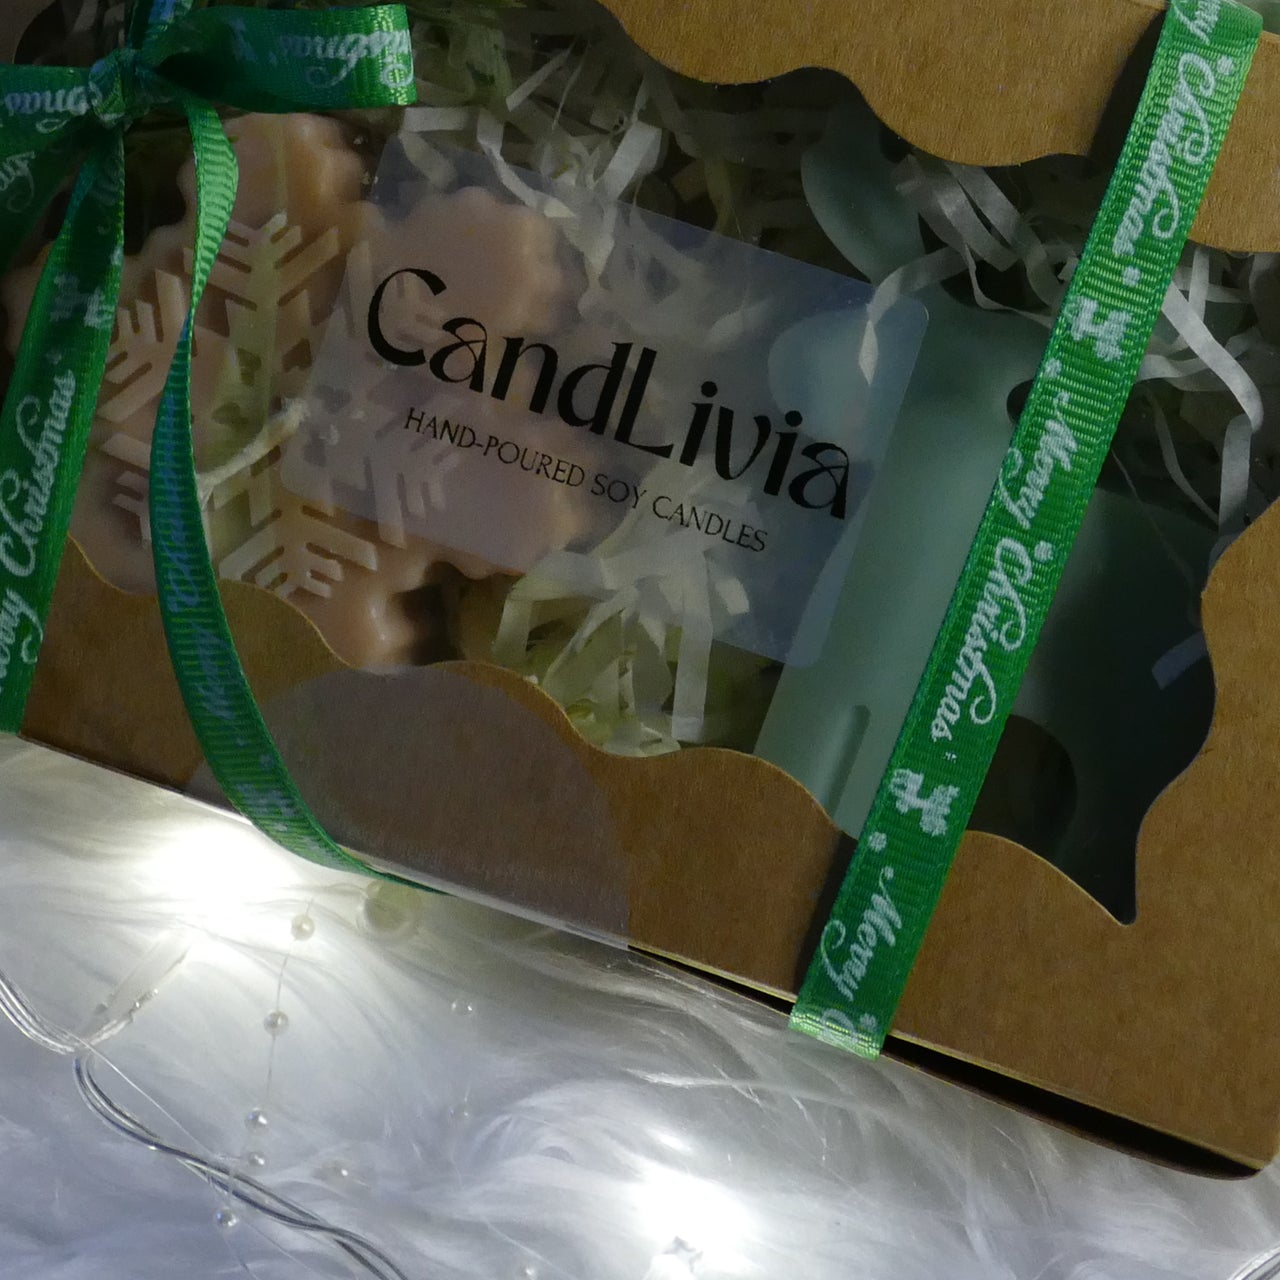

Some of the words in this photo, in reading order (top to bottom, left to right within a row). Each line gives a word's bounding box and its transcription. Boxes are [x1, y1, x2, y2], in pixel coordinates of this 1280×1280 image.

[1112, 51, 1217, 258] Christmas
[366, 266, 851, 520] CandLivia
[403, 407, 586, 488] HAND-POURED
[590, 472, 648, 510] SOY
[652, 494, 770, 554] CANDLES
[998, 391, 1079, 530] Merry
[930, 536, 1034, 742] Christmas
[820, 865, 904, 1002] Merry
